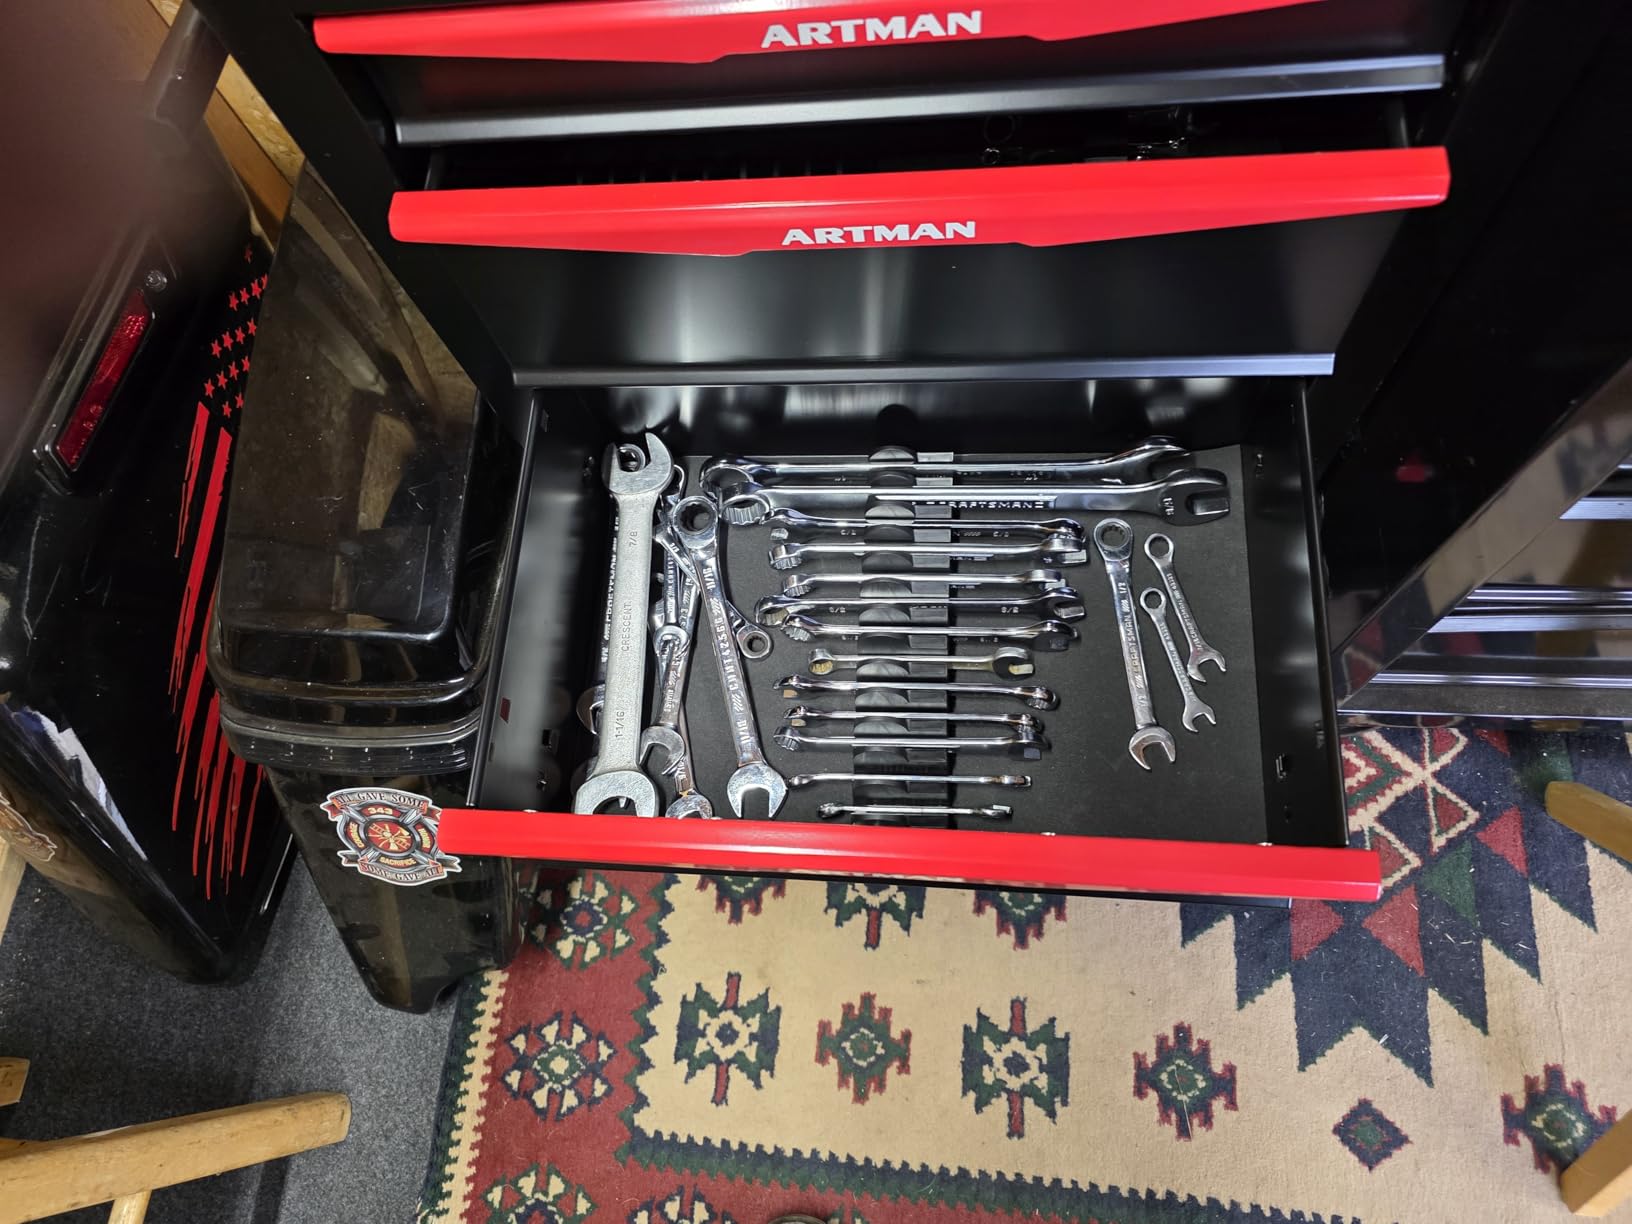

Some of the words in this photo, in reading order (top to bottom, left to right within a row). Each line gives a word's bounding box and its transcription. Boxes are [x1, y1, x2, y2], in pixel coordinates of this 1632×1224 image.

[761, 10, 982, 48] ARTMAN
[782, 221, 976, 246] ARTMAN
[621, 600, 632, 652] CRESCENT
[1121, 614, 1141, 673] CRAFTSMAN
[357, 792, 386, 801] GAVE
[391, 793, 424, 809] SOME
[367, 807, 393, 815] 343
[395, 871, 421, 881] GAVE
